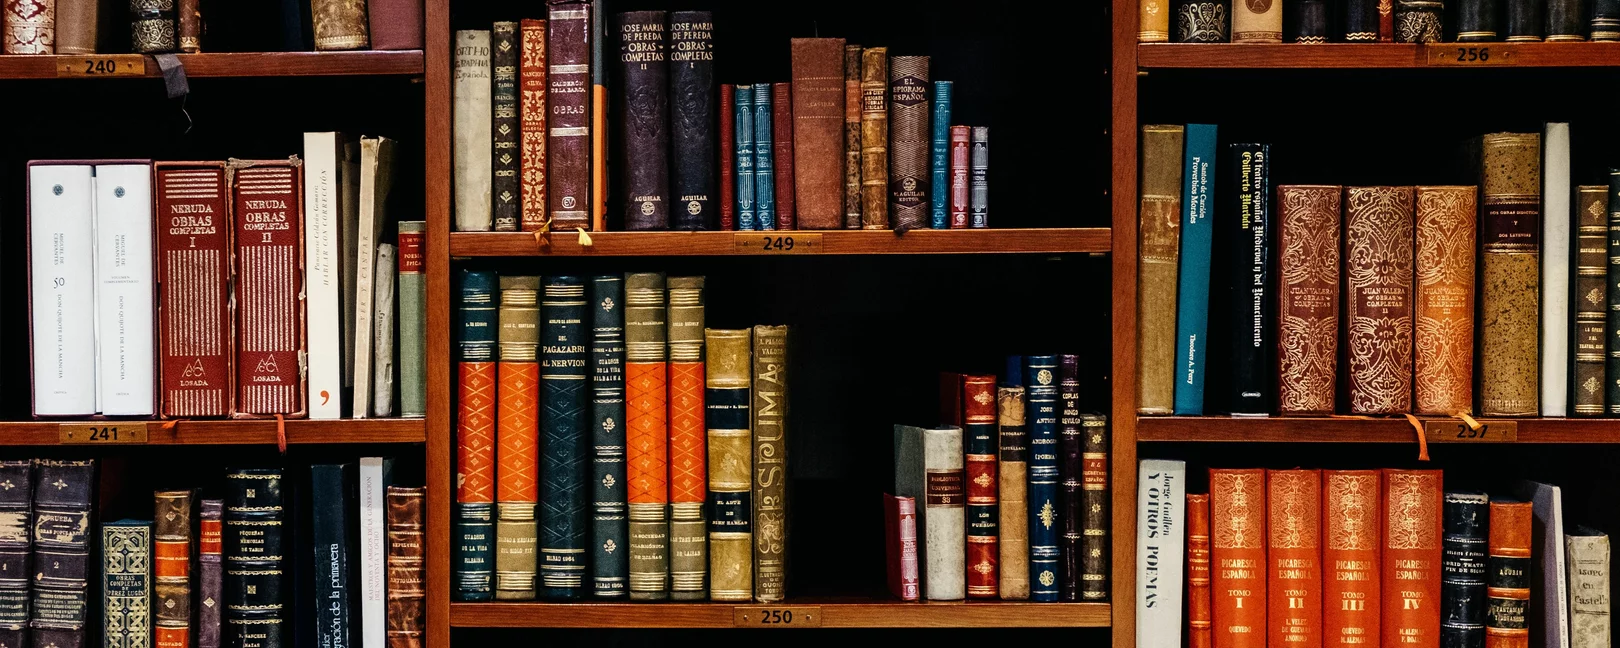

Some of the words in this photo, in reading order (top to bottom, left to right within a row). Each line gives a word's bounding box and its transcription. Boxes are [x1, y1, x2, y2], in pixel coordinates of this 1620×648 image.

[628, 43, 656, 51] OBRAS
[678, 42, 705, 50] OBRAS
[622, 52, 664, 61] COMPLETAS
[671, 52, 713, 60] COMPLETAS
[1457, 48, 1489, 61] 256
[85, 60, 116, 74] 240
[554, 106, 584, 114] OBRAS
[1191, 157, 1200, 194] Proverbios
[1242, 152, 1251, 192] Edilberto
[1254, 164, 1263, 189] teatro
[171, 204, 213, 213] NERUDA
[245, 200, 287, 210] NERUDA
[1253, 191, 1263, 222] español
[246, 212, 286, 222] OBRAS
[1240, 194, 1251, 229] Marbán
[172, 216, 212, 227] OBRAS
[170, 227, 216, 235] COMPLETAS
[189, 237, 196, 247] I
[262, 232, 272, 242] II
[763, 236, 794, 250] 249
[1253, 226, 1263, 264] Medieval
[1254, 274, 1263, 285] del
[1252, 288, 1263, 347] Renacimiento
[120, 345, 124, 353] LA
[89, 427, 118, 441] 241
[1457, 425, 1488, 438] 257
[1148, 473, 1160, 484] Y
[1163, 473, 1173, 499] Jorge
[1148, 488, 1160, 539] OTROS
[1163, 502, 1173, 536] Guillén
[328, 543, 342, 588] primavera
[1221, 559, 1256, 568] PICARESCA
[1278, 559, 1313, 568] PICARESCA
[1146, 545, 1158, 608] POEMAS
[1222, 569, 1255, 579] ESPAÑOLA
[1279, 570, 1312, 579] ESPAÑOLA
[1236, 598, 1243, 608] I
[1289, 598, 1304, 608] II
[1342, 600, 1364, 610] III
[1404, 599, 1422, 610] IV
[329, 602, 340, 616] de
[762, 610, 792, 623] 250
